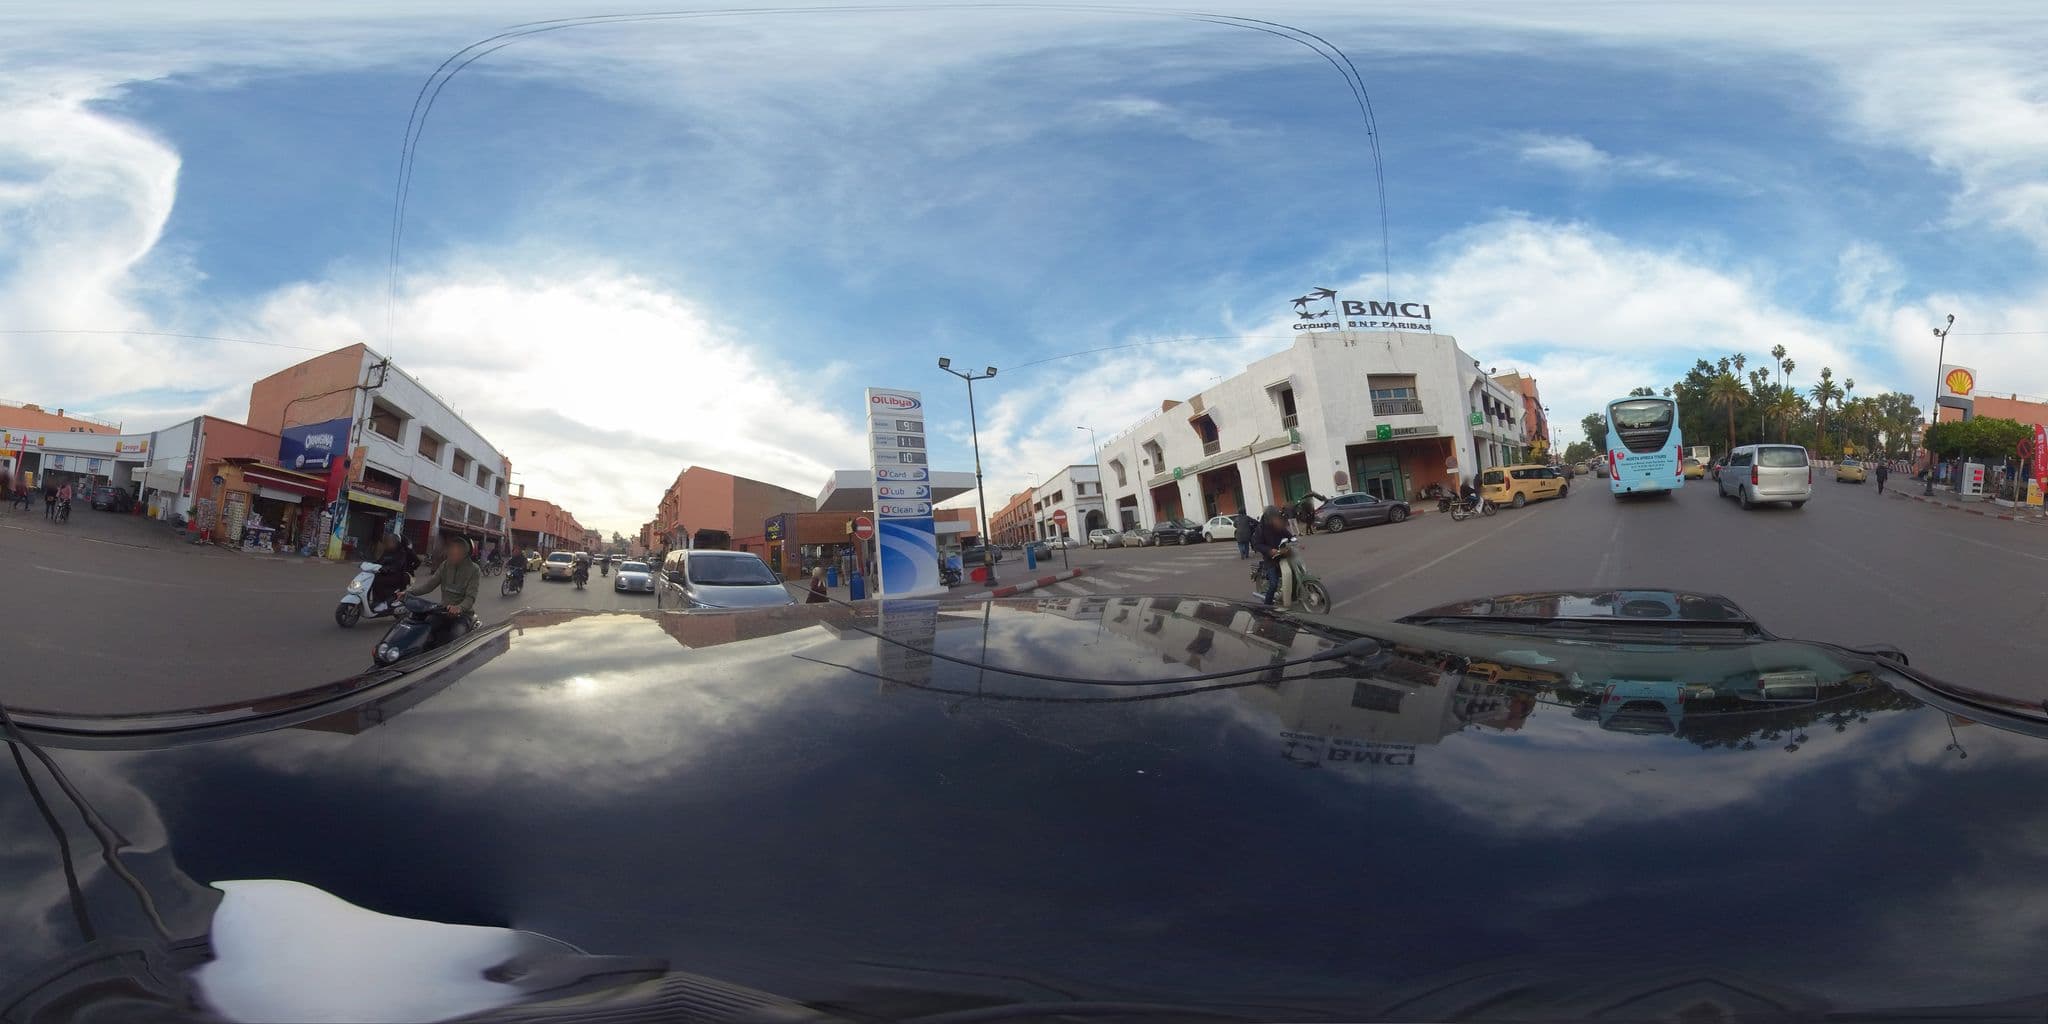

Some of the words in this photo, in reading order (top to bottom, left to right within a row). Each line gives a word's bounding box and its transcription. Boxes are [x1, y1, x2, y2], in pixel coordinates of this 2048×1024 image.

[1341, 300, 1431, 319] BMCI
[1293, 321, 1340, 331] Groupe
[1381, 321, 1432, 331] PARIBAS
[879, 469, 906, 478] O'Card
[881, 505, 913, 514] O'Clean
